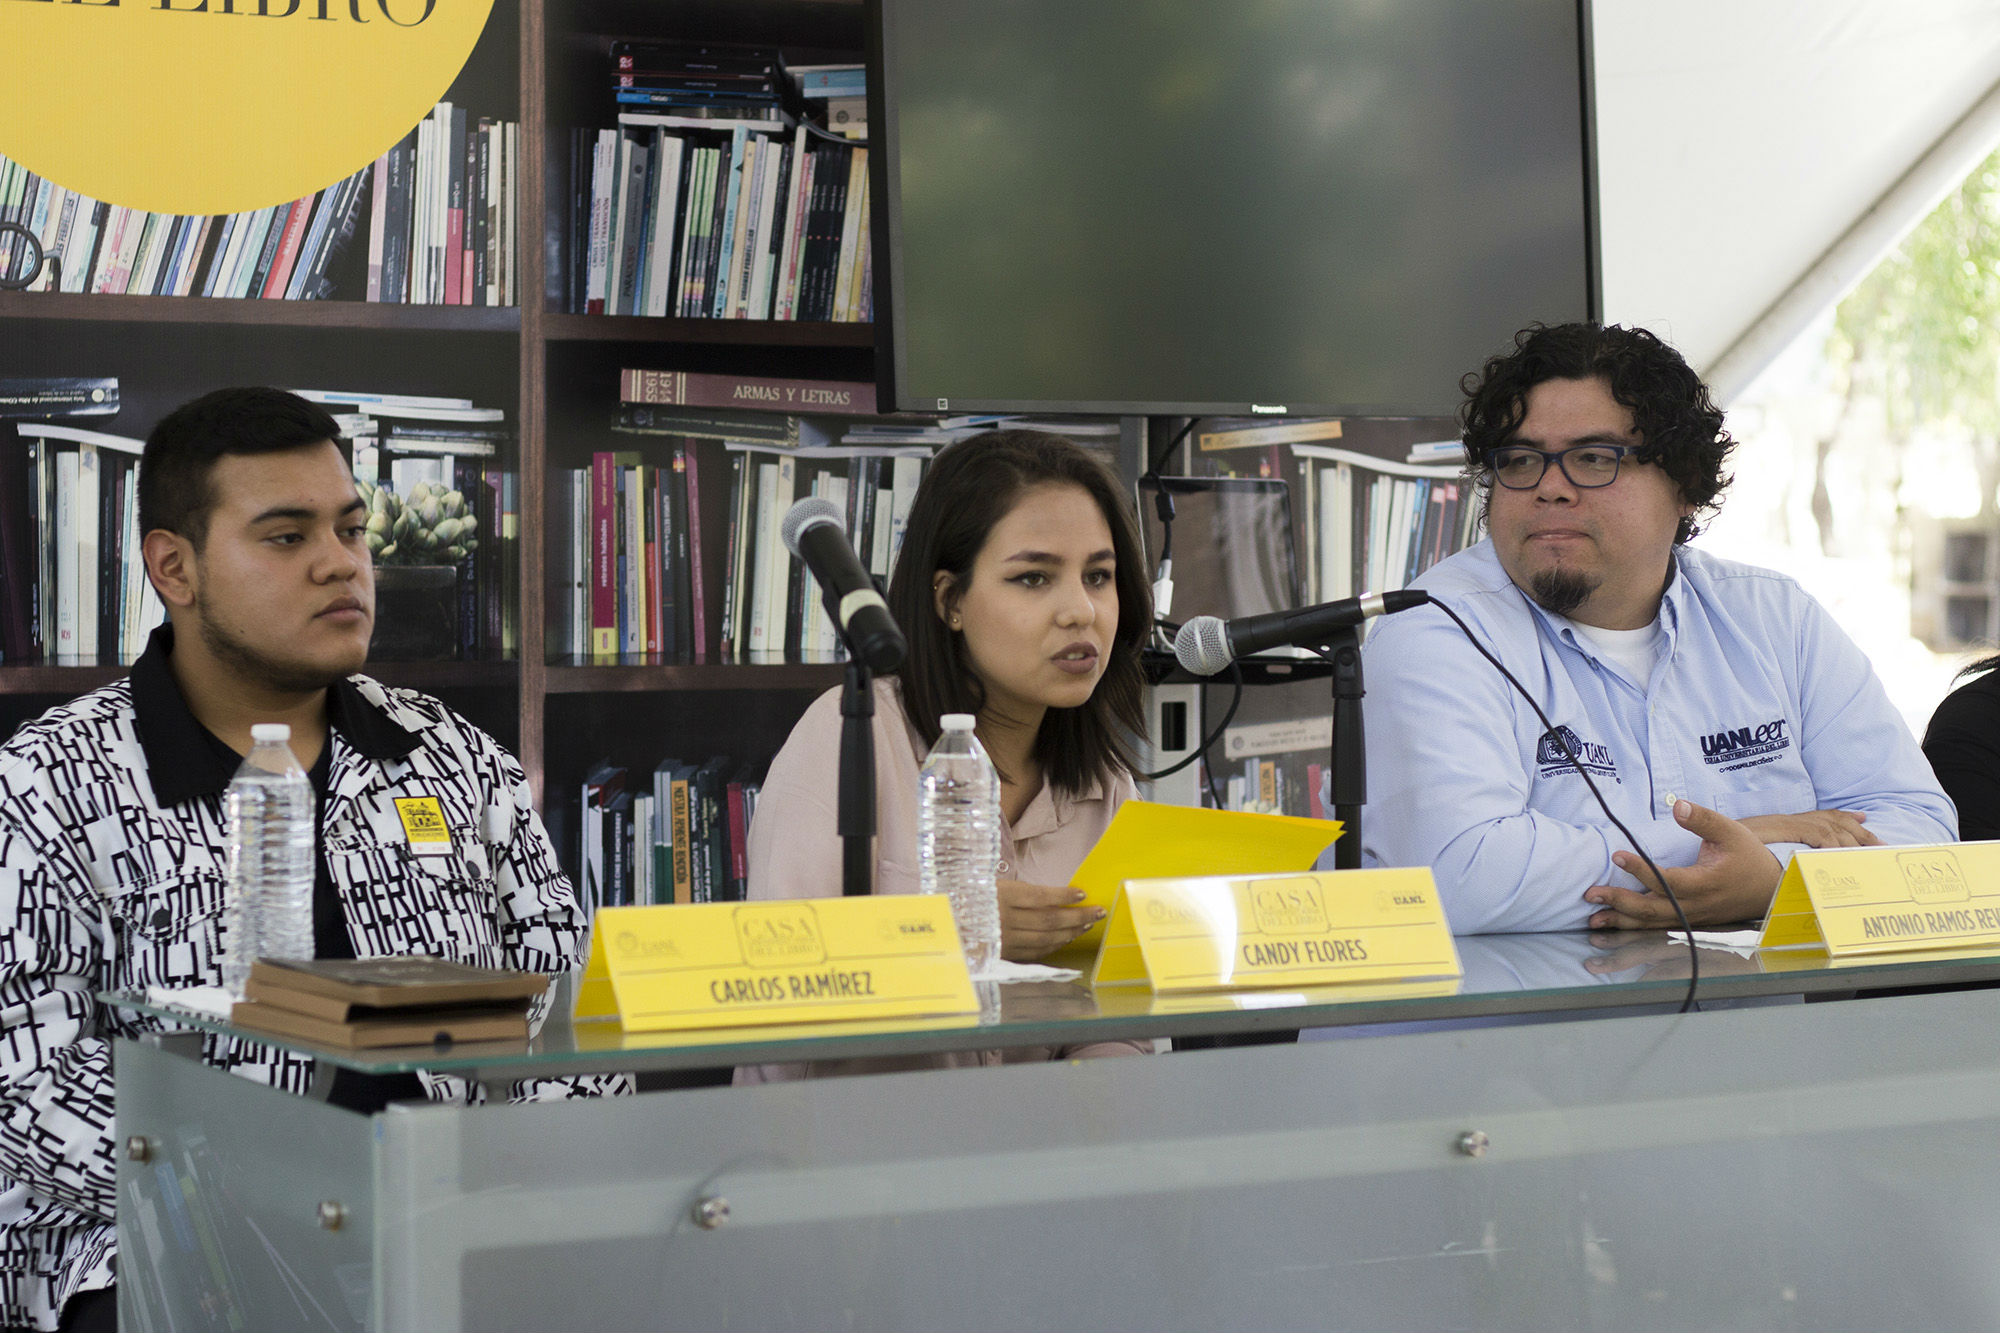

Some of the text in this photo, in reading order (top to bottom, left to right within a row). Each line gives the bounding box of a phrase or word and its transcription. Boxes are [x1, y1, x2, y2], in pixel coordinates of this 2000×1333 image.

[645, 370, 658, 402] 1955
[733, 385, 850, 404] ARMAS Y LETRAS
[600, 519, 608, 586] retratos hablados
[1700, 719, 1786, 755] UANLeer
[1583, 743, 1614, 765] UANL
[674, 787, 683, 815] NUESTRA
[615, 853, 622, 862] DE
[1906, 862, 1958, 879] CASA
[615, 879, 621, 887] DE
[1914, 884, 1964, 895] DEL LIBRO
[1257, 890, 1317, 910] CASA
[742, 916, 815, 938] CASA
[1862, 913, 1925, 938] ANTONIO
[1926, 910, 1975, 934] RAMOS
[1243, 939, 1367, 966] CANDY FLORES
[711, 970, 875, 1004] CARLOS RAMÍREZ
